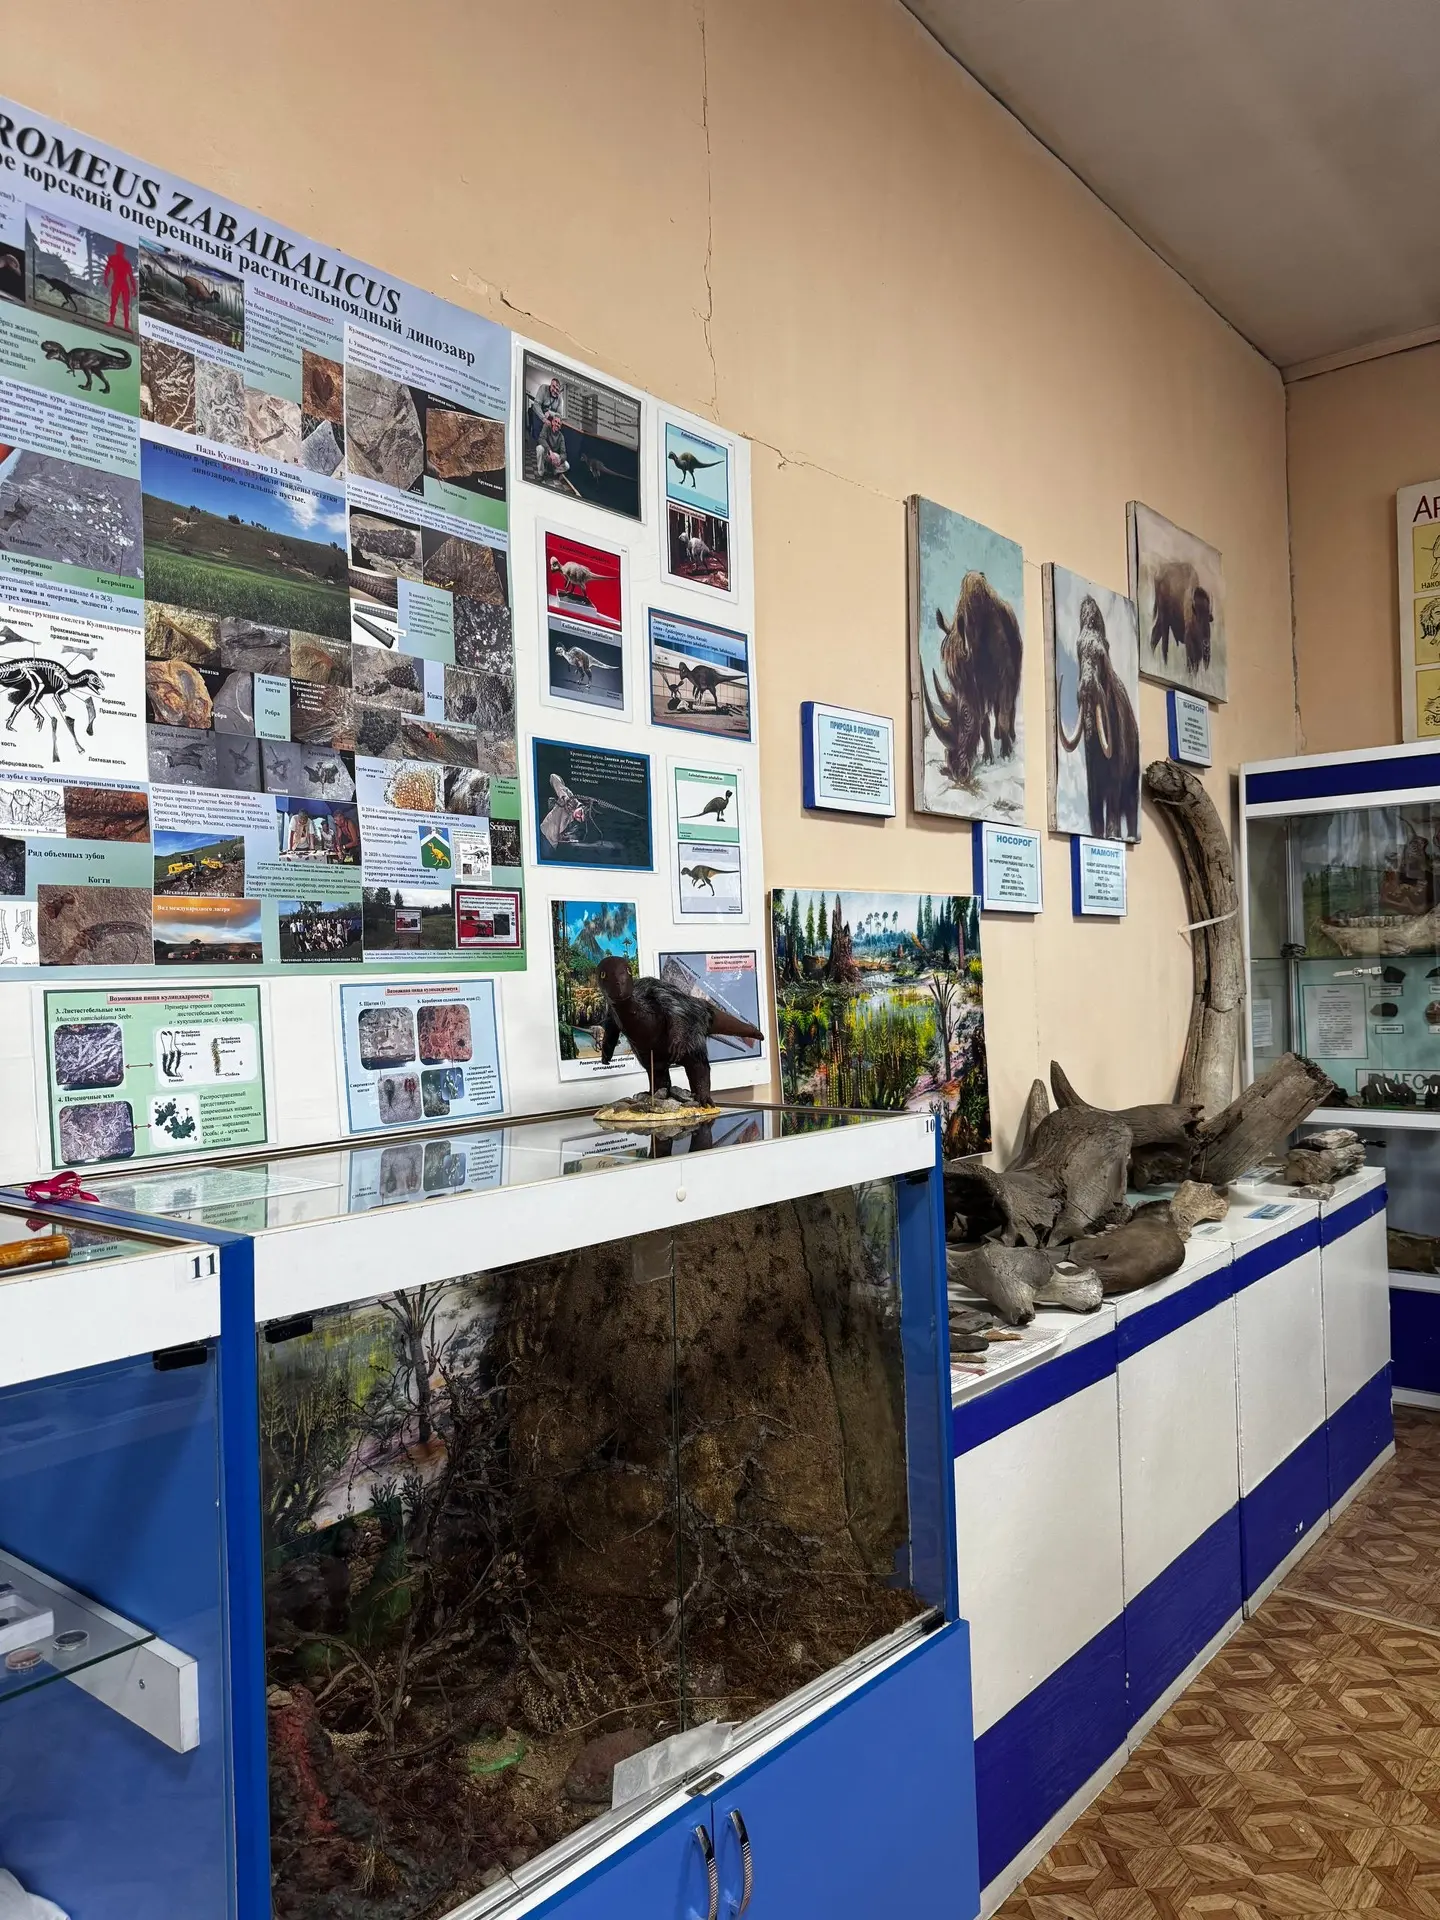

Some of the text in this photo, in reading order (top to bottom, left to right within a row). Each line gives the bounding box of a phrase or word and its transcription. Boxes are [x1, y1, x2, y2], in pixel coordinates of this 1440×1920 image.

[0, 113, 401, 315] ROMEUS ZABAIKALICUS
[23, 162, 112, 213] юрский
[119, 204, 233, 263] оперенный
[238, 253, 402, 335] растительноядный
[406, 327, 475, 366] динозавр
[5, 381, 47, 399] современные
[58, 414, 87, 428] помогают
[64, 407, 104, 424] растительной
[95, 441, 126, 454] совместно
[196, 444, 216, 457] Падь
[218, 451, 249, 466] Кулинда
[270, 466, 278, 475] 13
[239, 479, 277, 496] остальные
[279, 490, 306, 504] пустые.
[280, 480, 310, 495] найдены
[1, 553, 52, 570] Пучкообразное
[12, 565, 43, 577] оперение
[97, 576, 135, 590] Гастролиты
[5, 593, 20, 601] трех
[99, 707, 117, 715] Правая
[264, 708, 281, 717] Ребра
[1183, 701, 1205, 714] БИЗОН
[830, 720, 853, 733] ПРИРОДА
[7, 772, 24, 780] зубы
[30, 774, 77, 785] зазубренными
[490, 822, 513, 831] Science
[996, 835, 1032, 847] НОСОРОГ
[28, 849, 43, 857] Ряд
[44, 850, 83, 859] объемных
[1090, 847, 1120, 859] МАМОНТ
[88, 876, 111, 884] Когти
[109, 994, 142, 1002] Возможная
[62, 1006, 113, 1014] Листостебельные
[200, 1090, 246, 1100] Распространенный
[925, 1118, 934, 1132] 10
[191, 1253, 218, 1279] 11
